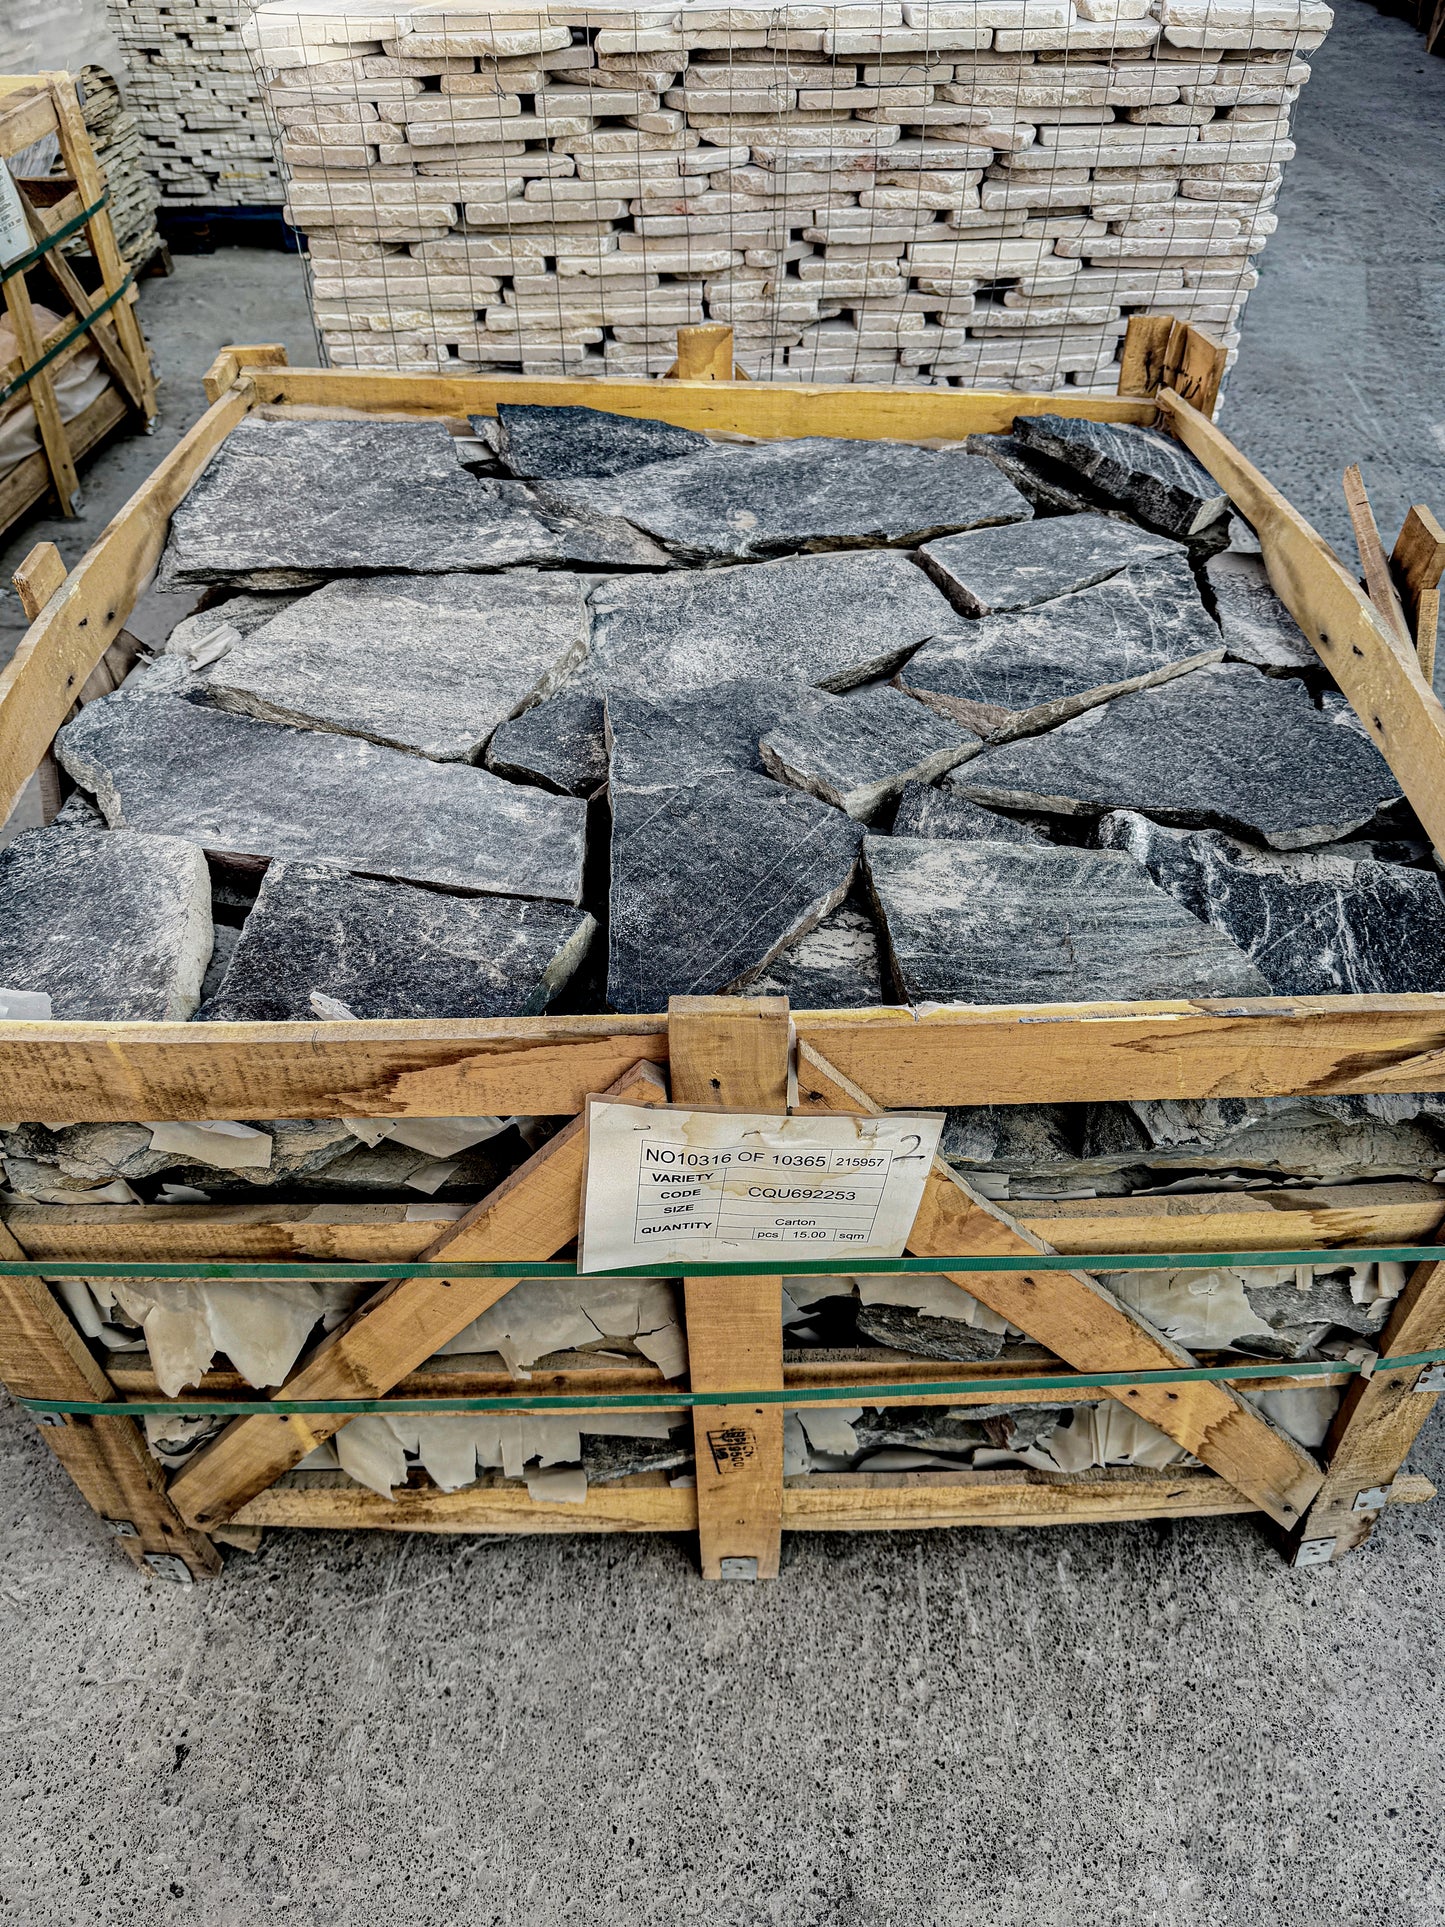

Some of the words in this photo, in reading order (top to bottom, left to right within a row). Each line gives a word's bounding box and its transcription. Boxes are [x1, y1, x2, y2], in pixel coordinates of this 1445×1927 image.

[892, 1134, 926, 1162] 2
[646, 1148, 732, 1166] NO10316
[737, 1151, 765, 1163] OF
[772, 1154, 826, 1167] 10365
[836, 1157, 885, 1168] 215957
[652, 1172, 714, 1184] VARIETY
[660, 1188, 702, 1200] CODE
[748, 1186, 856, 1201] CQU692253
[663, 1203, 695, 1215] SIZE
[641, 1221, 713, 1235] QUANTITY
[775, 1218, 816, 1227] Carton
[757, 1231, 780, 1239] pcs
[793, 1231, 827, 1239] 15.00
[839, 1232, 865, 1241] sqm
